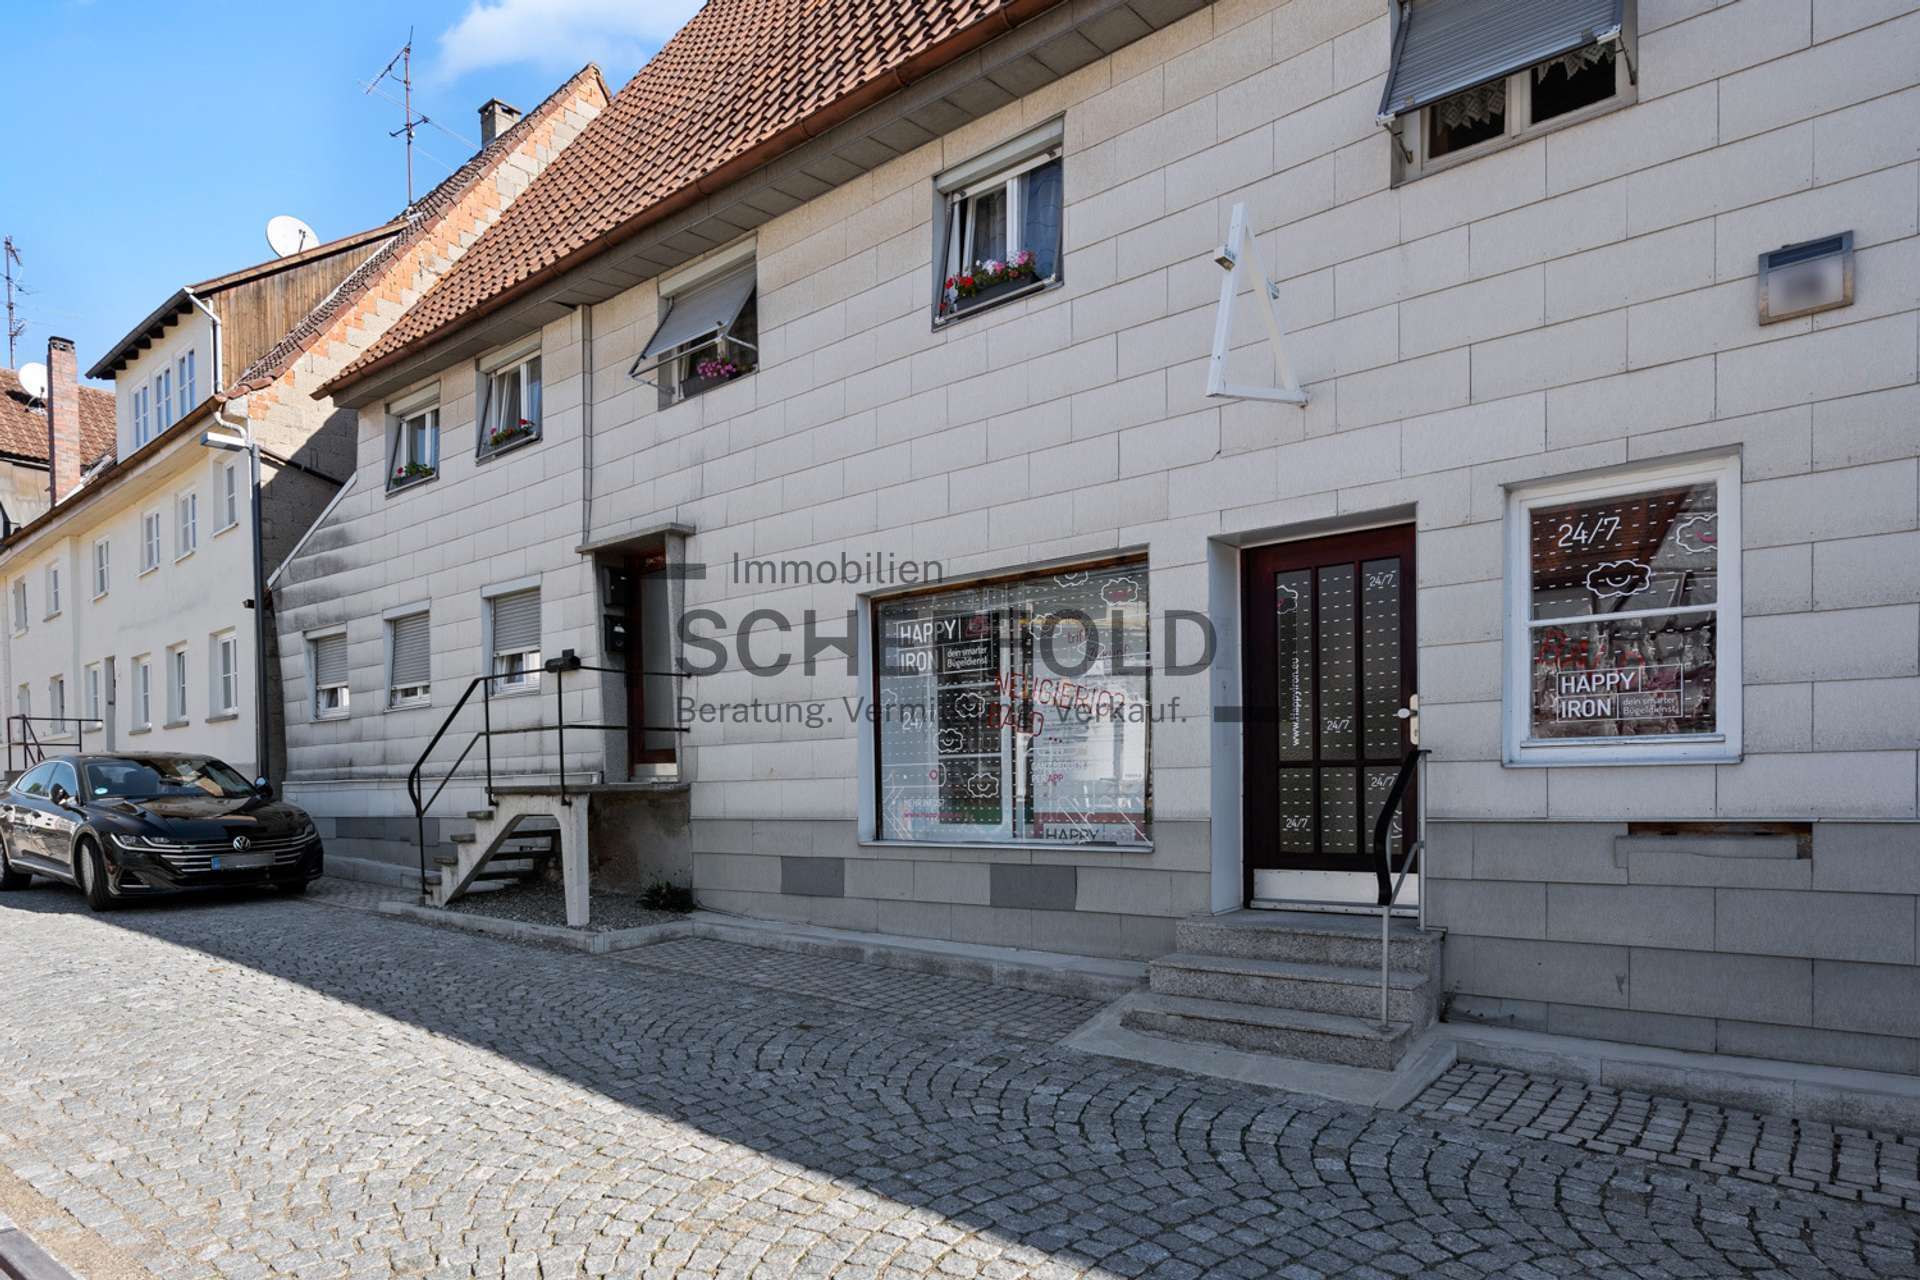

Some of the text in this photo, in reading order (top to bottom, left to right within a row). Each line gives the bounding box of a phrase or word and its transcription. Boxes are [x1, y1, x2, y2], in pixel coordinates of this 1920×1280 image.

[1558, 517, 1620, 547] 24/7
[1369, 574, 1394, 587] 24/7
[900, 619, 956, 643] HAPPY
[900, 650, 938, 672] IRON
[1561, 671, 1635, 694] HAPPY
[1561, 698, 1612, 719] IRON
[1327, 719, 1350, 731] 24/7
[1371, 775, 1396, 787] 24/7
[1286, 817, 1308, 828] 24/7
[1045, 828, 1099, 840] HAPPY
